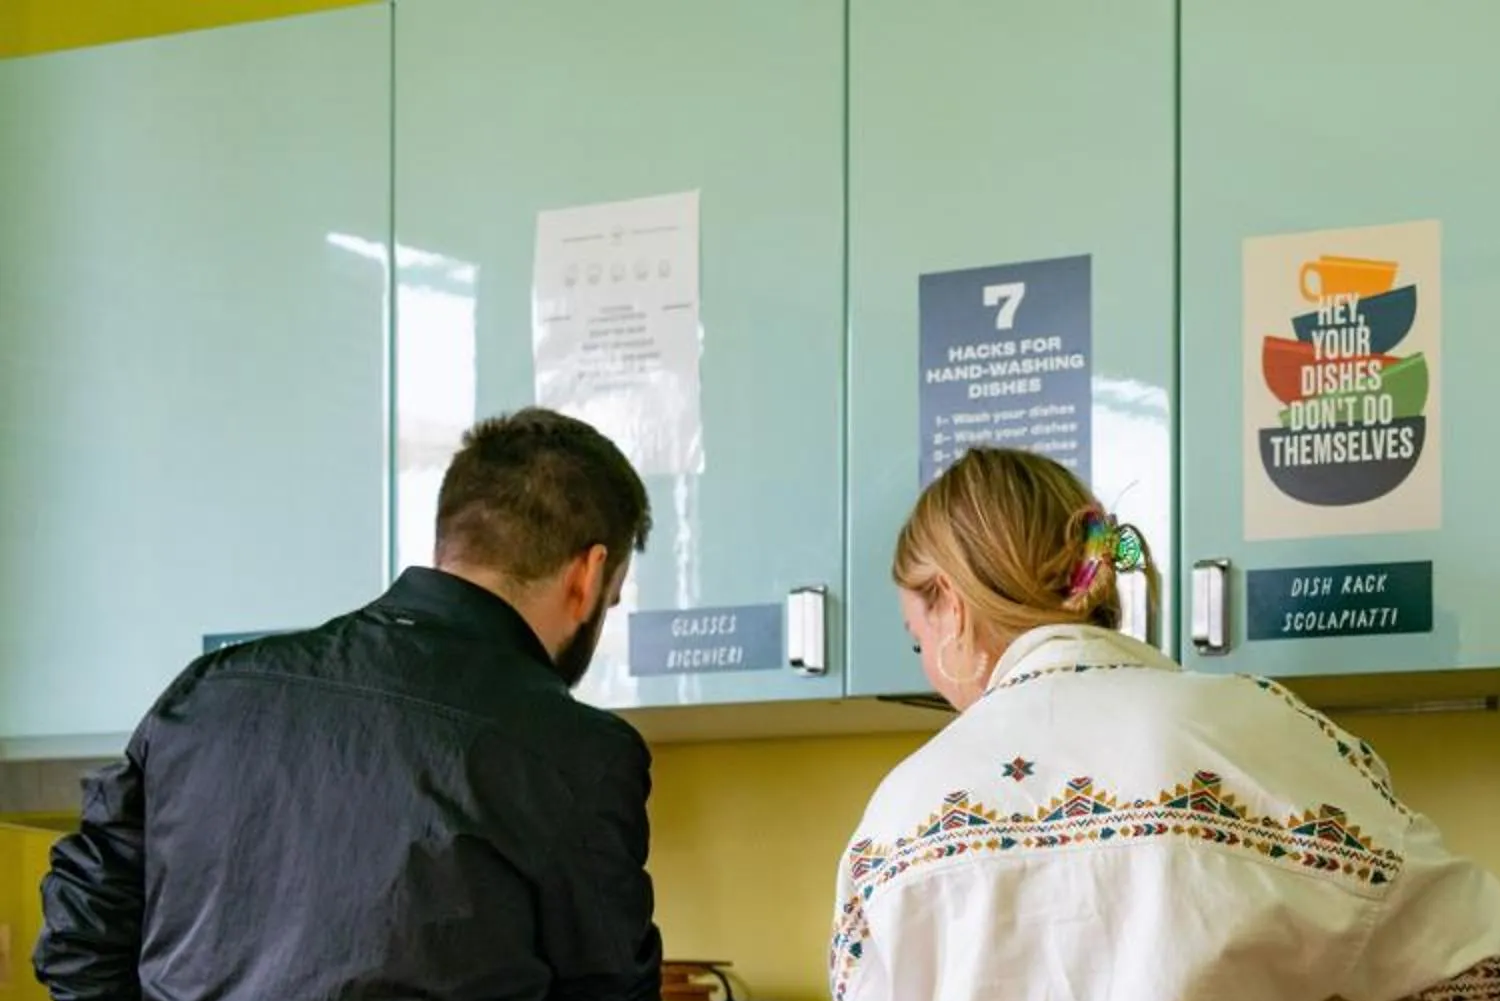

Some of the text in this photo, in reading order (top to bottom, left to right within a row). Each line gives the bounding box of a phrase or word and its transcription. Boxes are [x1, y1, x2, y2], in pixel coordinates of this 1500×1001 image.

[982, 281, 1026, 330] 7
[1317, 292, 1365, 328] HEY,
[948, 335, 1062, 363] HACKS FOR
[1311, 327, 1371, 361] YOUR
[926, 354, 1085, 384] HAND-WASHING
[1300, 360, 1383, 397] DISHES
[968, 377, 1042, 400] DISHES
[951, 411, 991, 425] Wash
[992, 408, 1027, 424] your
[1029, 404, 1077, 418] dishes
[1290, 393, 1394, 432] DON'T DO
[994, 425, 1028, 441] your
[1030, 421, 1078, 436] dishes
[1269, 427, 1415, 468] THEMSELVES
[1290, 574, 1389, 597] DISH RACK
[671, 614, 738, 638] GLASSES
[1281, 607, 1399, 633] SCOLAPIATTI
